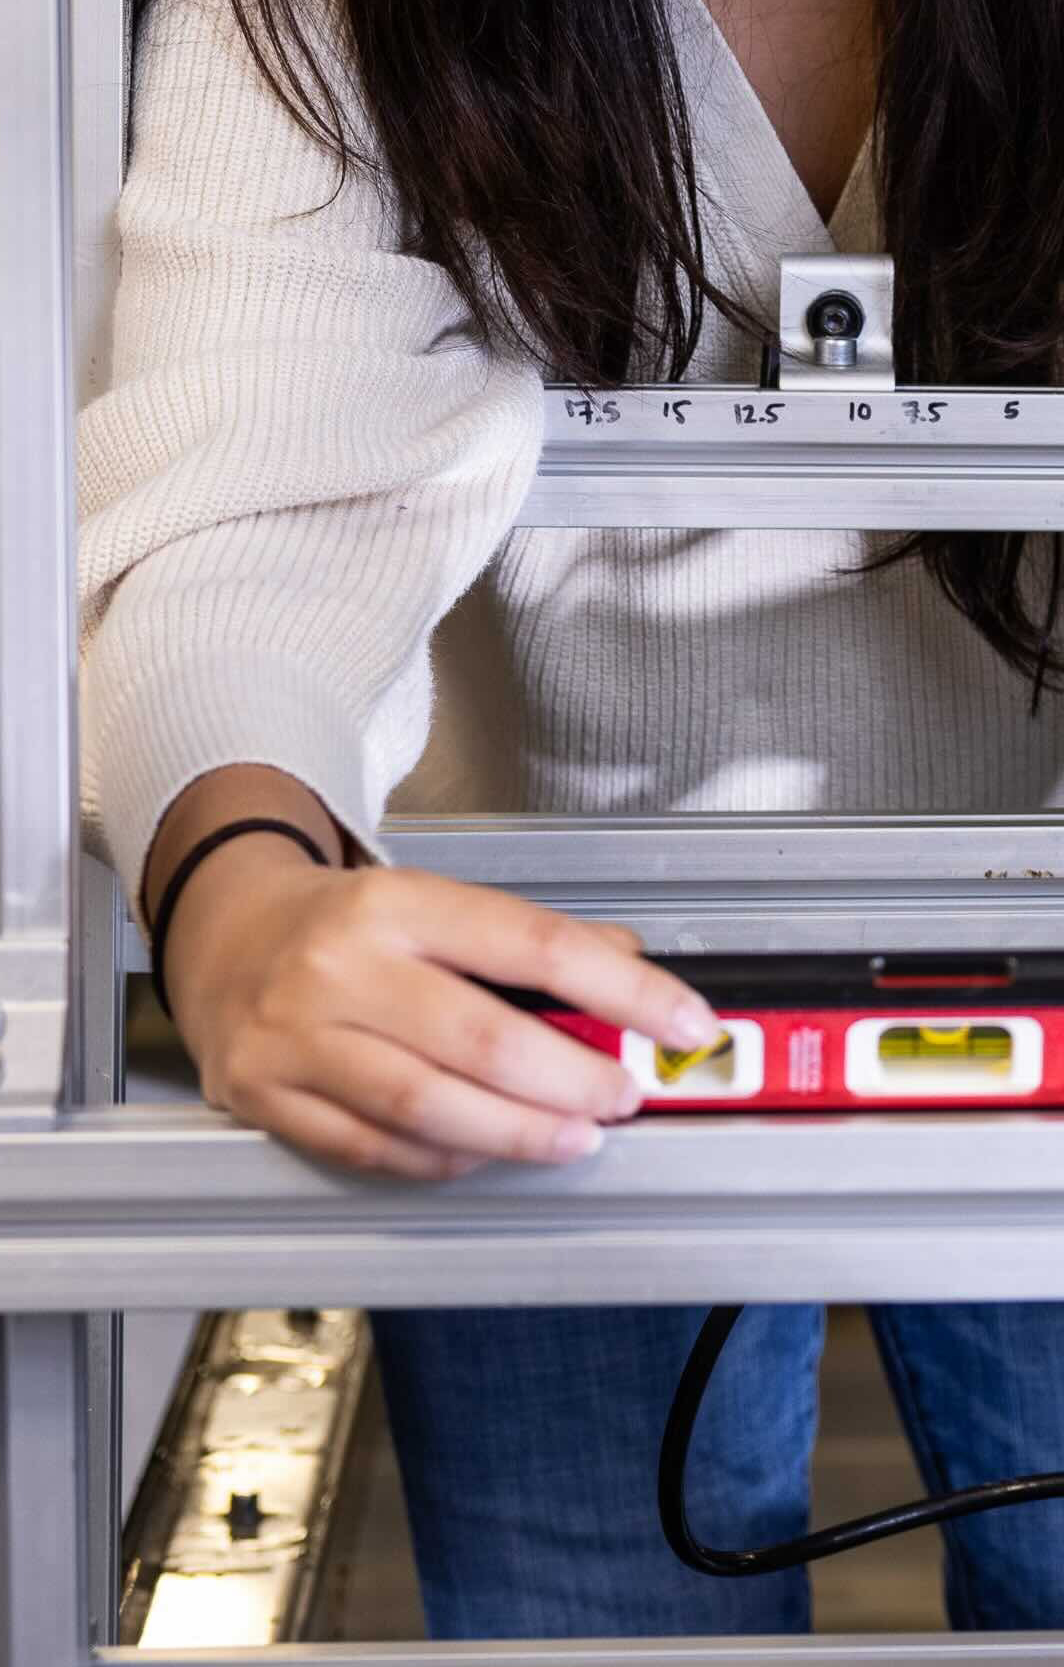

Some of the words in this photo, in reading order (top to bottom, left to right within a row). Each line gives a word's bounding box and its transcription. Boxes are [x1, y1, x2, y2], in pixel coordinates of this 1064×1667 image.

[565, 399, 621, 425] 17.5
[663, 399, 692, 424] 15
[733, 403, 786, 425] 12.5
[849, 401, 872, 422] 10
[902, 400, 948, 424] 7.5
[1004, 400, 1020, 420] 5
